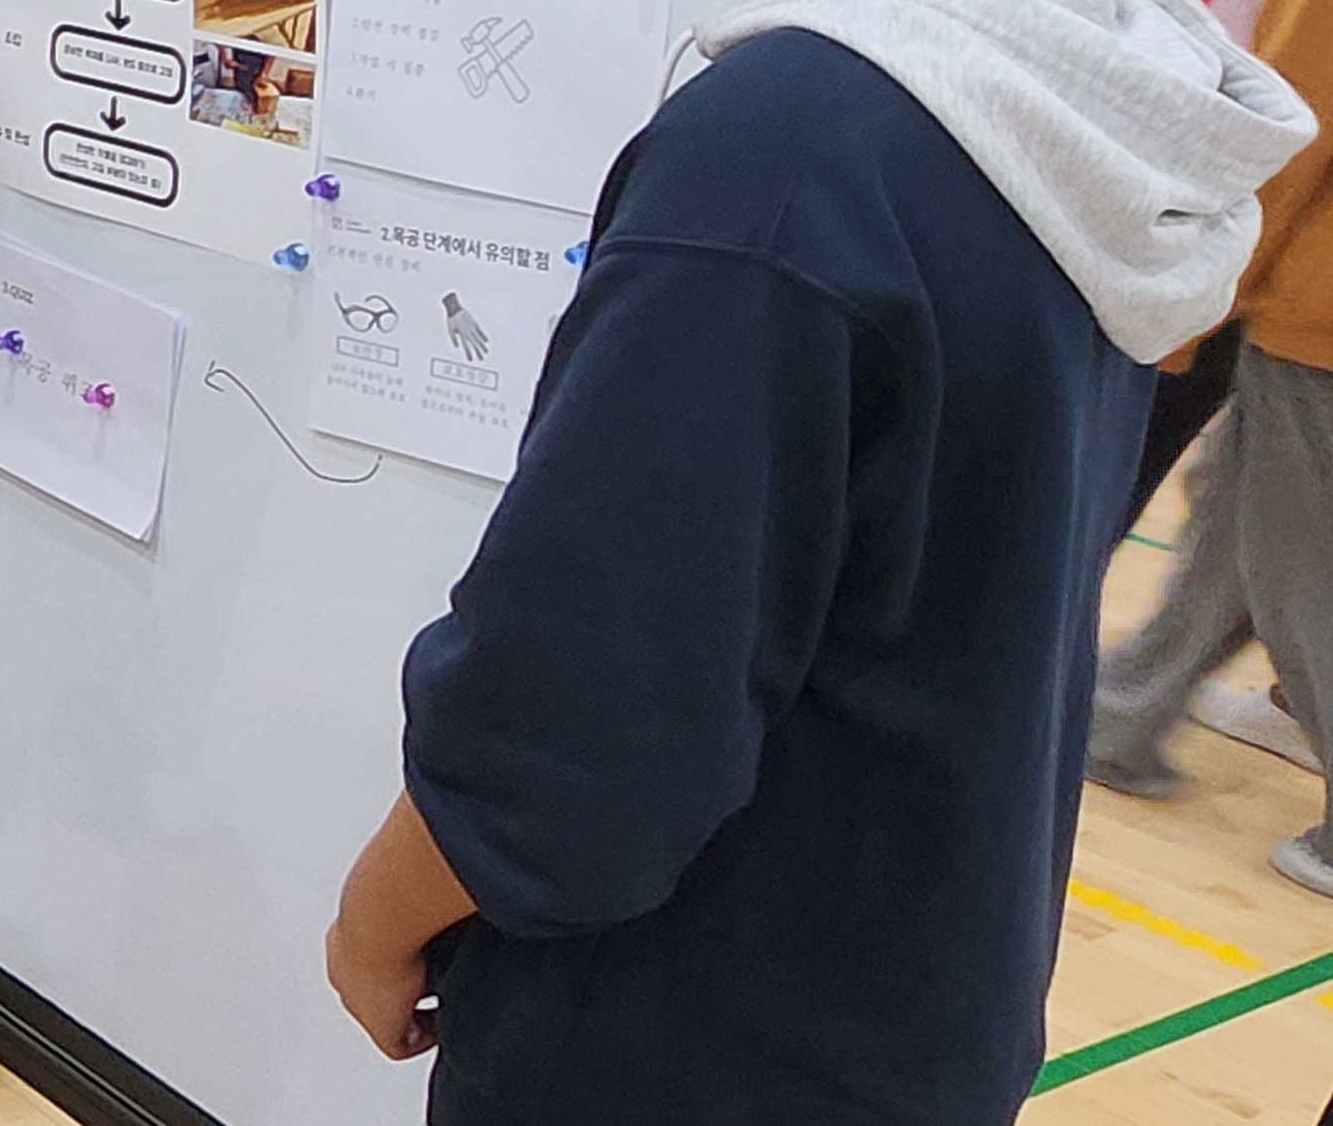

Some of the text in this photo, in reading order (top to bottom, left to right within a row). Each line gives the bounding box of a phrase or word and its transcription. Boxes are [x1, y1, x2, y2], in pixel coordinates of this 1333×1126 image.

[423, 232, 482, 259] 단계에서
[485, 242, 531, 268] 유의할
[534, 250, 550, 271] 점
